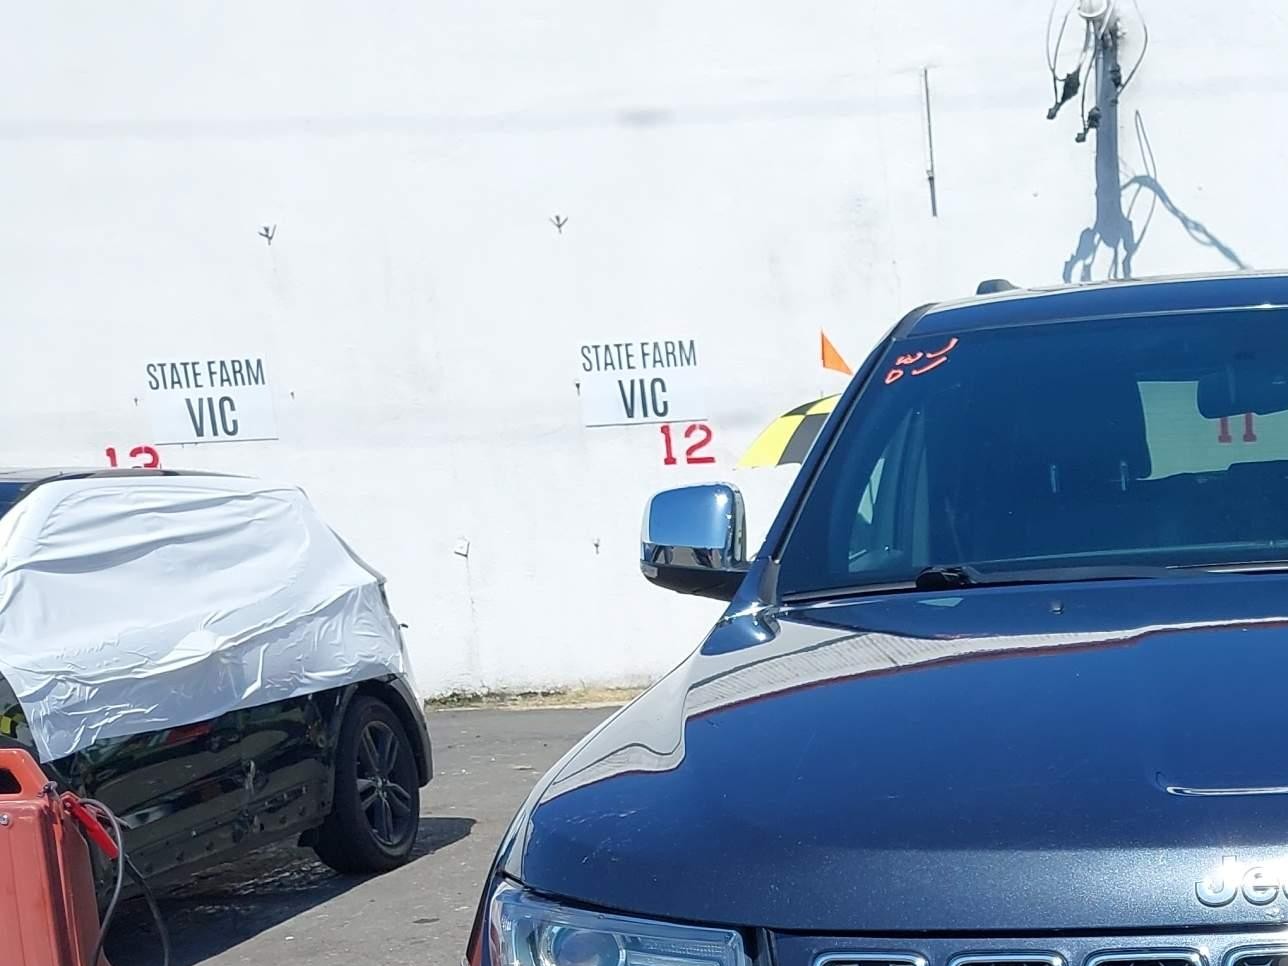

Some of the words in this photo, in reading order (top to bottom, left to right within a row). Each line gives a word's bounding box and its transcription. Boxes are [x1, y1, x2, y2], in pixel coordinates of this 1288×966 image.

[146, 361, 204, 390] STATE
[207, 358, 266, 388] FARM
[579, 343, 636, 372] STATE
[640, 339, 697, 368] FARM
[185, 396, 239, 437] VIC
[618, 377, 669, 418] VIC
[660, 423, 716, 465] 12
